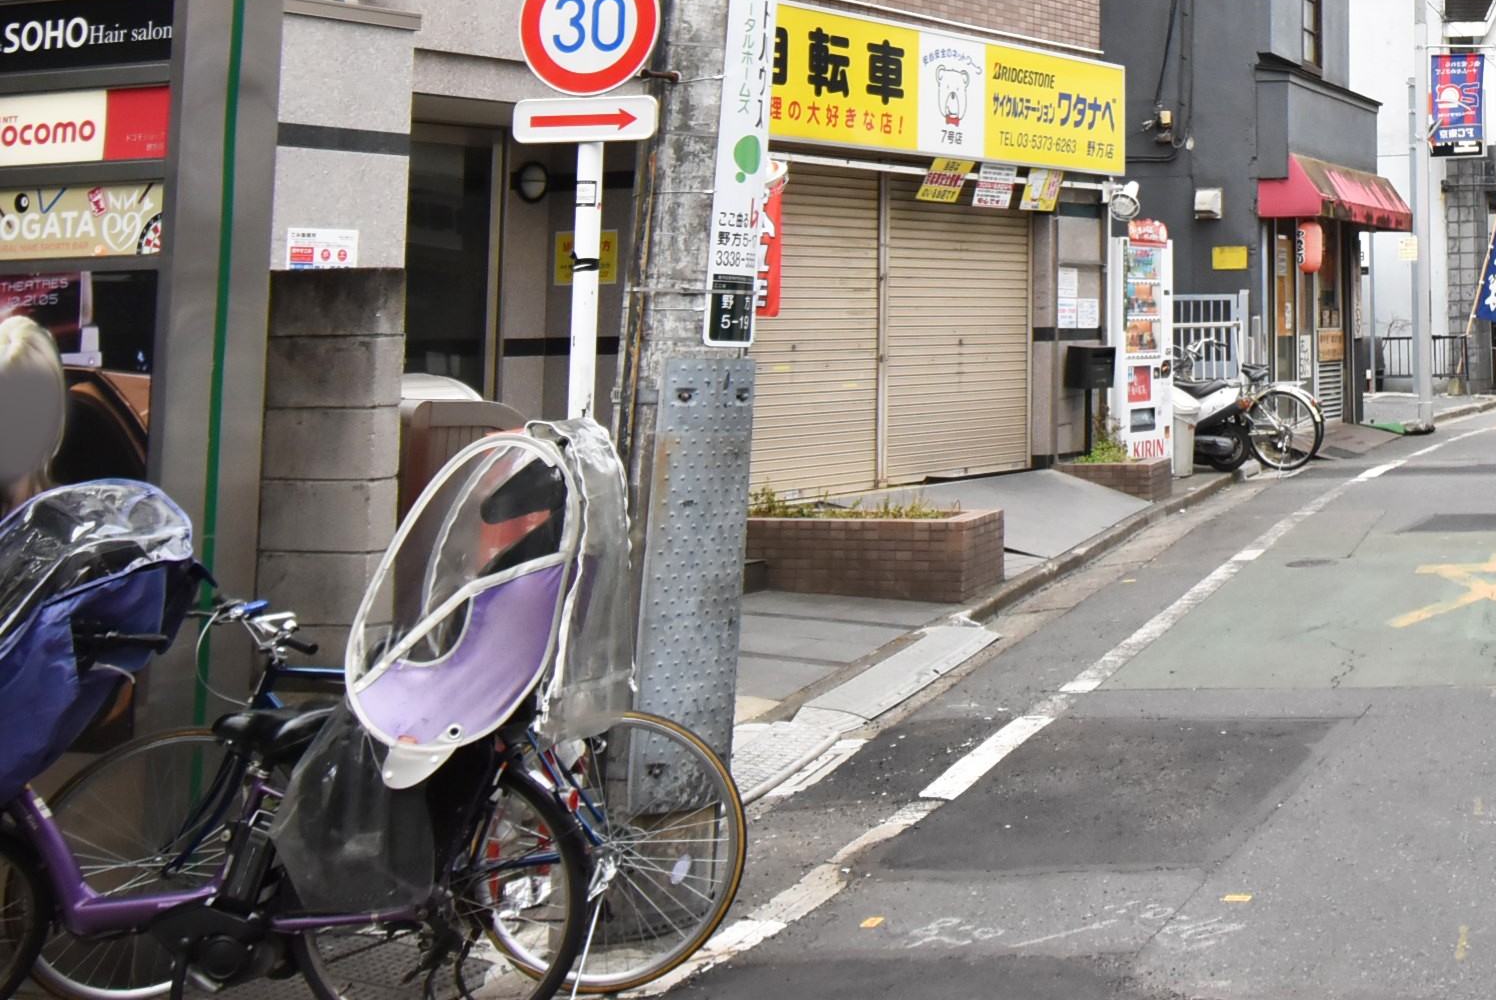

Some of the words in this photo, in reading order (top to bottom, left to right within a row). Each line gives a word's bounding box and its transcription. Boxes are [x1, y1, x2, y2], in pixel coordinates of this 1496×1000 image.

[3, 16, 88, 54] SOHO
[88, 23, 128, 45] Hair
[130, 20, 173, 41] salon
[992, 62, 1056, 89] BRIDGESTONE
[992, 92, 1056, 125] サイクルステーション
[1057, 91, 1118, 133] ワタナベ
[0, 119, 96, 147] ocomo
[940, 129, 963, 145] 7号店
[999, 130, 1015, 147] TEL
[1016, 132, 1077, 154] 03-5373-6263
[1086, 139, 1115, 160] 野方店
[720, 314, 750, 330] 5-19
[1133, 438, 1165, 458] KIRIN
